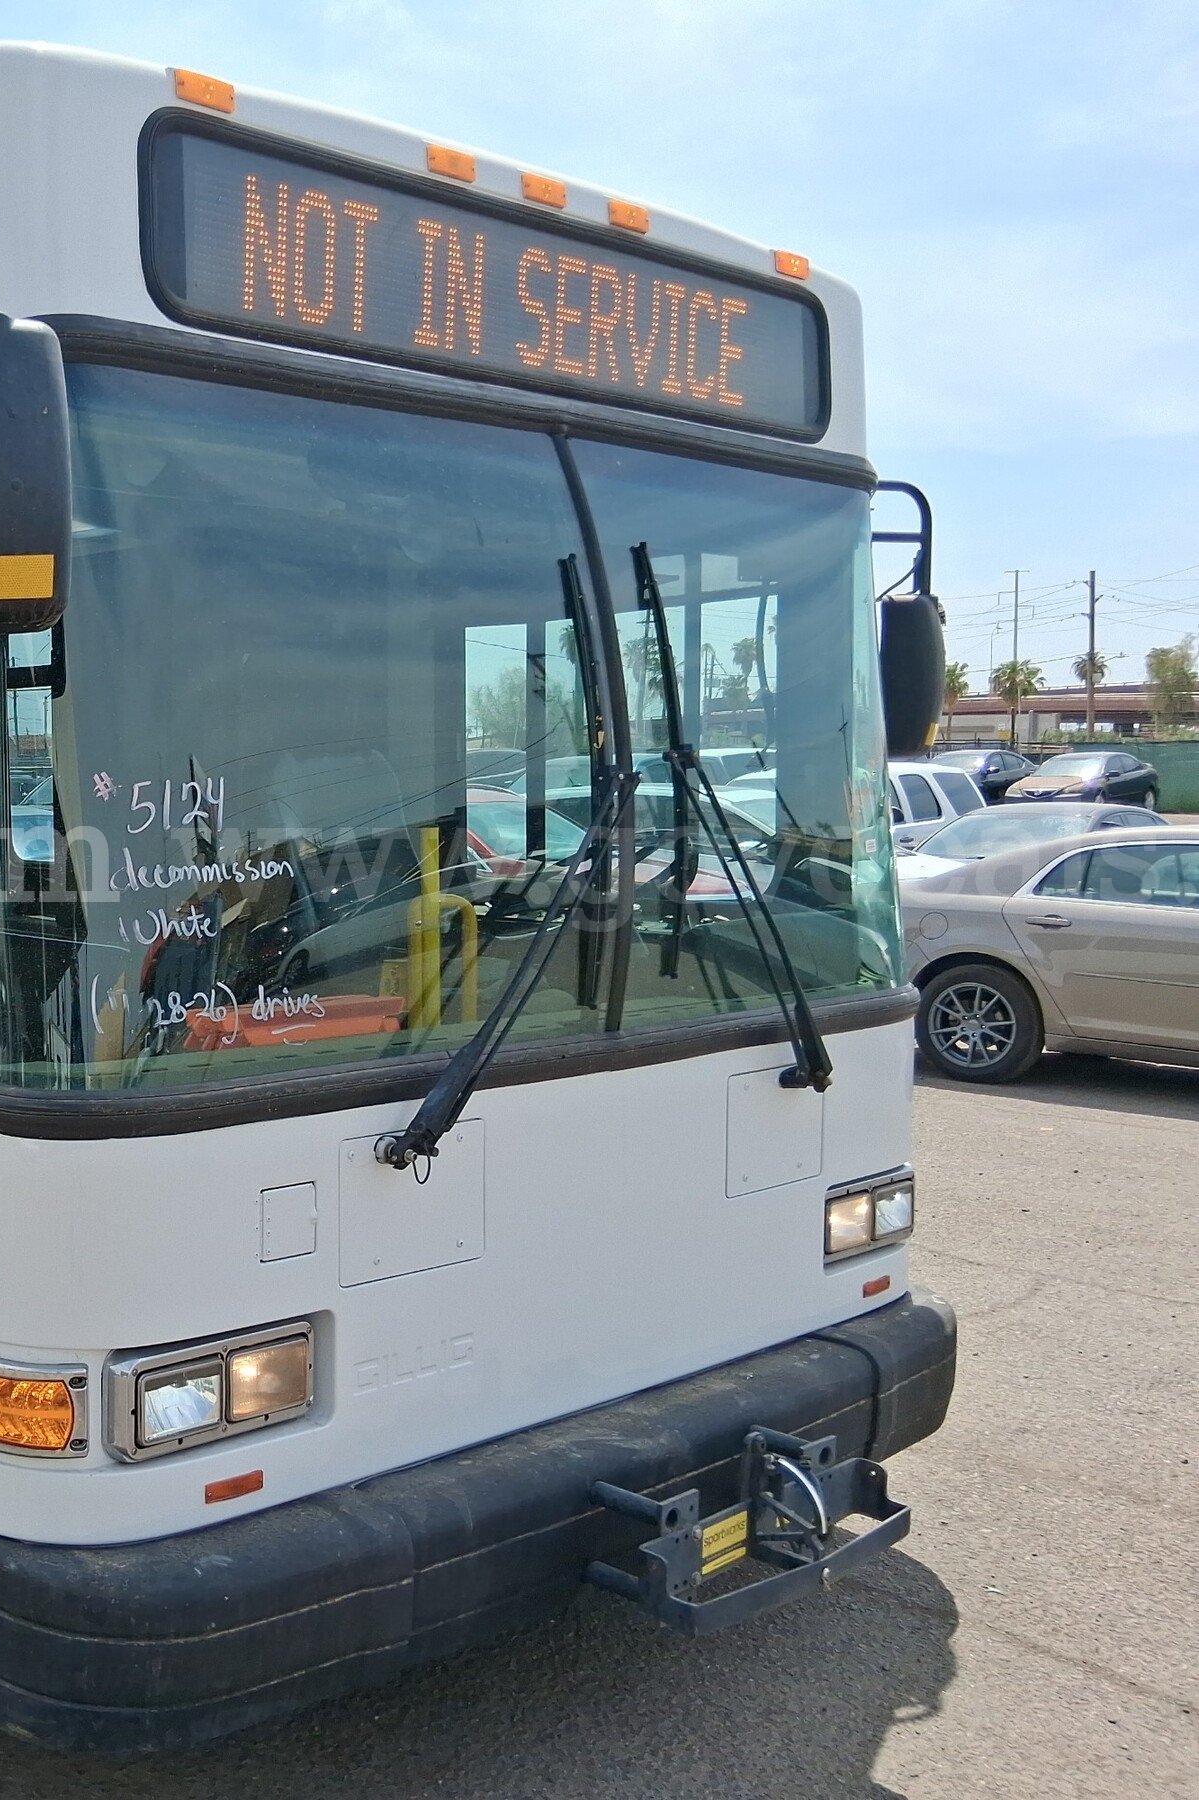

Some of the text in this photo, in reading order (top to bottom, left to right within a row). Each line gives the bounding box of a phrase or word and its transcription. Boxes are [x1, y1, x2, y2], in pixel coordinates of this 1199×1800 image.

[242, 174, 749, 408] NOT IN SERVICE
[110, 846, 295, 892] decommission
[118, 904, 218, 946] White
[252, 984, 326, 1022] drives
[352, 1331, 474, 1397] GILLIG
